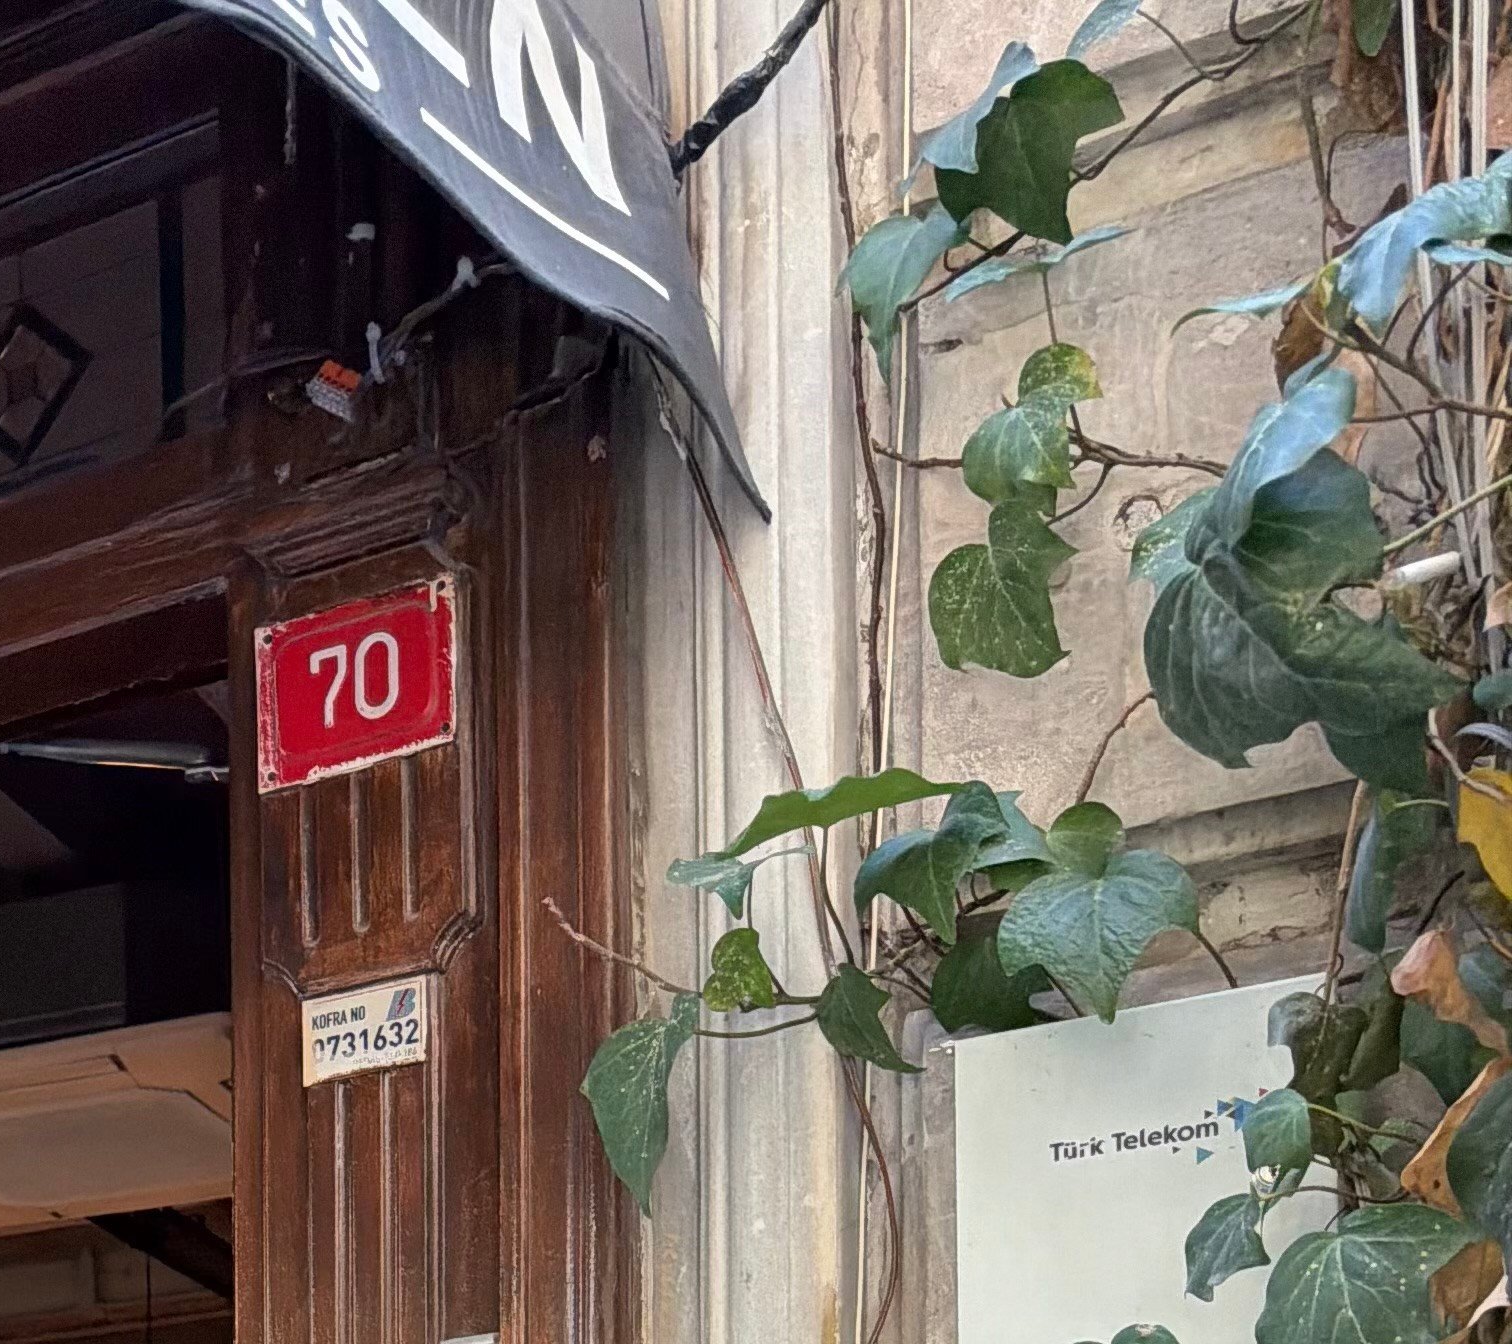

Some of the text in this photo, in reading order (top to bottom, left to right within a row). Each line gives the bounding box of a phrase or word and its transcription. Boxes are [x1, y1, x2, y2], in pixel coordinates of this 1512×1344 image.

[309, 631, 399, 729] 70
[312, 1005, 366, 1031] KOFRA NO
[1049, 1120, 1220, 1163] Türk Telekom
